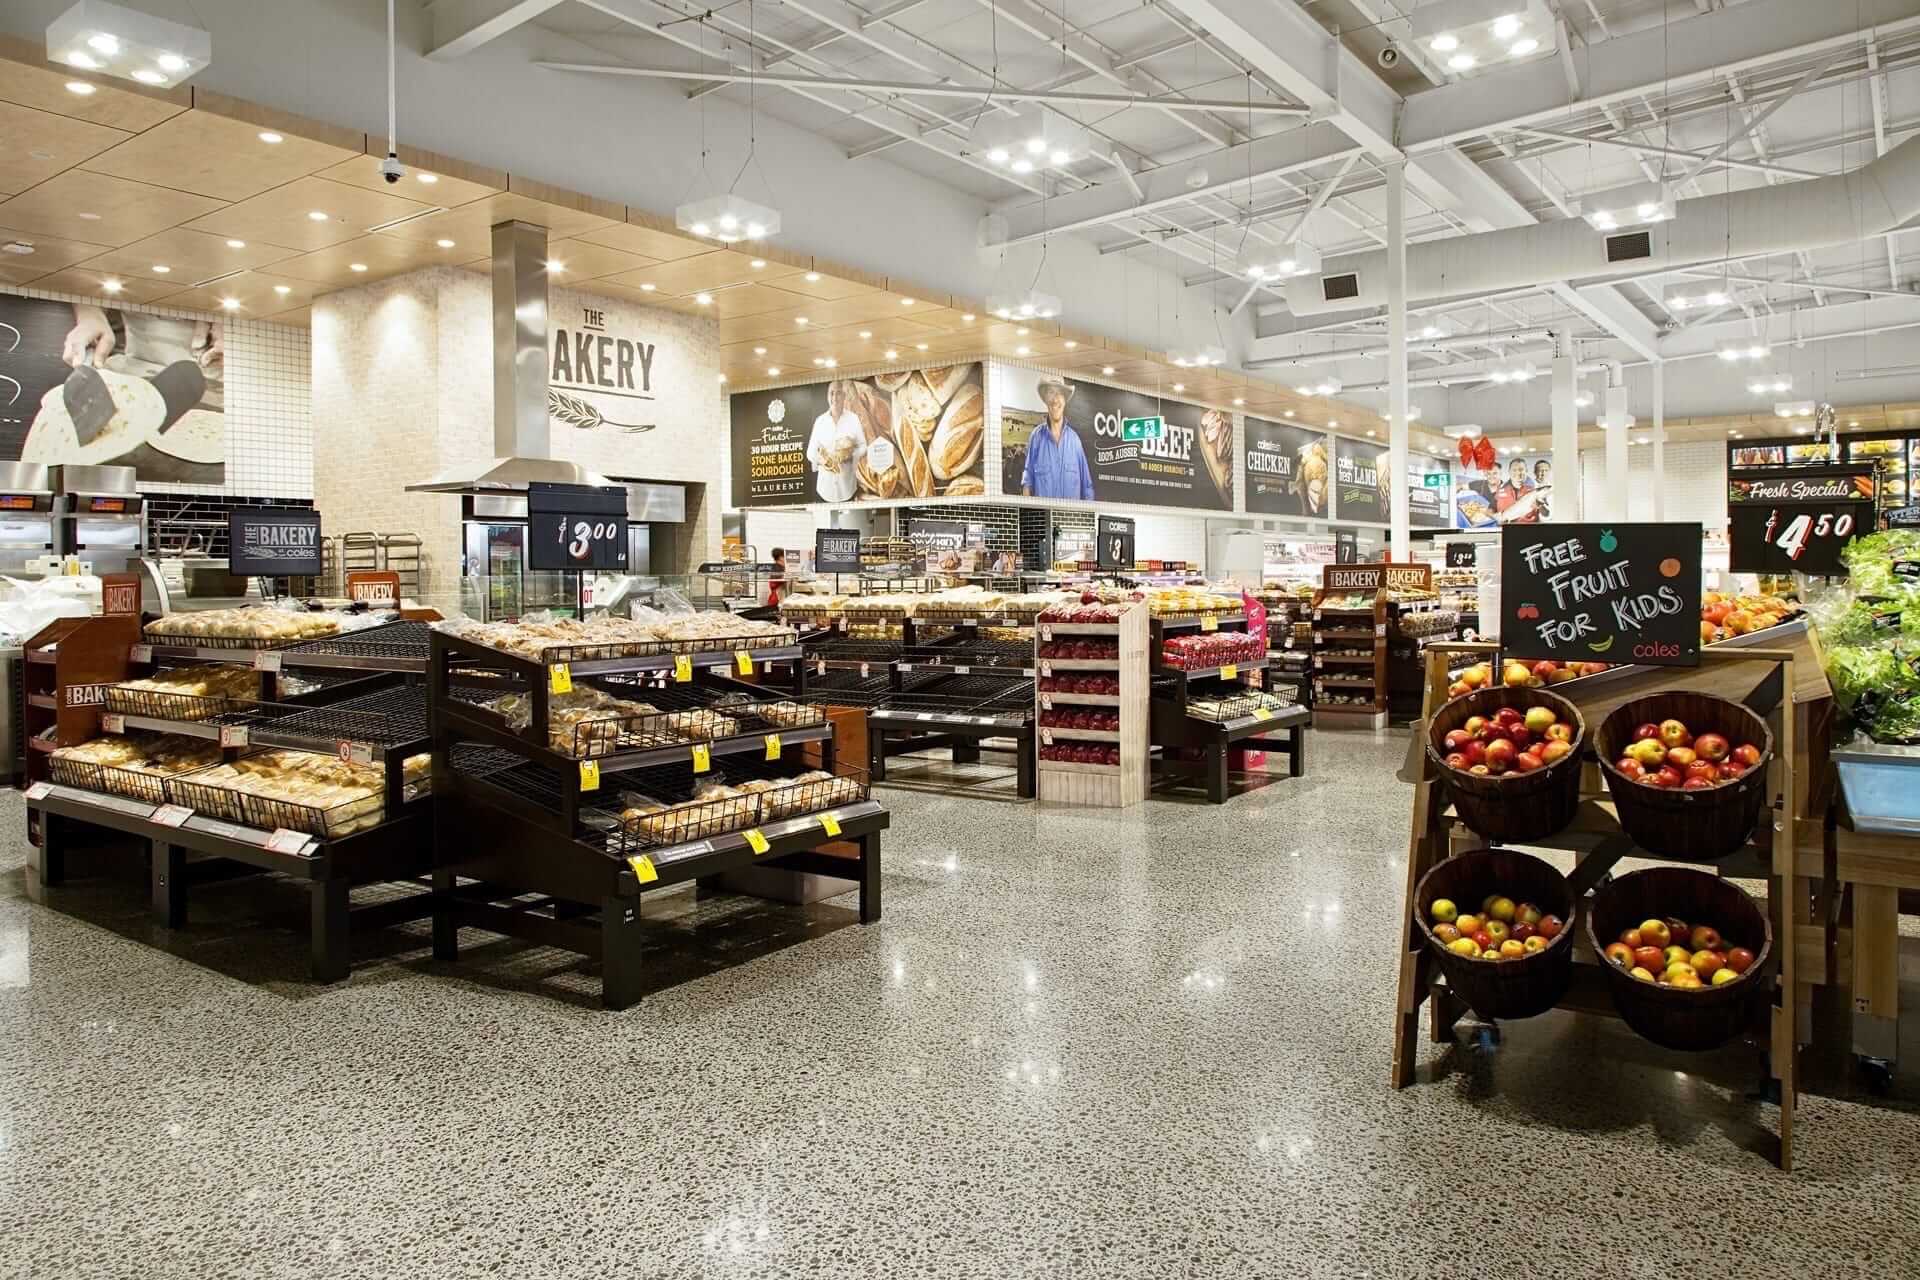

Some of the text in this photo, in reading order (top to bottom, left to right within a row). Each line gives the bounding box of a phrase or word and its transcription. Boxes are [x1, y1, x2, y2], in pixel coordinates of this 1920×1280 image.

[583, 309, 604, 326] THE
[552, 329, 655, 392] AKERY
[1094, 409, 1128, 438] col
[751, 452, 804, 466] STONE BAKED
[1248, 450, 1290, 475] CHICKEN
[751, 463, 804, 477] SOURDOUGH
[1354, 466, 1376, 486] LAMB
[1750, 480, 1849, 500] Fresh Specials
[244, 526, 317, 545] THE BAKERY
[286, 547, 316, 557] coles
[830, 539, 858, 553] BAKERY
[1519, 538, 1587, 575] FREE
[1335, 571, 1380, 587] BAKERY
[1547, 559, 1632, 611] FRUIT
[110, 587, 136, 612] BAKERY
[1535, 584, 1684, 649] FOR KIDS
[1632, 641, 1681, 658] coles
[73, 685, 105, 705] BAK
